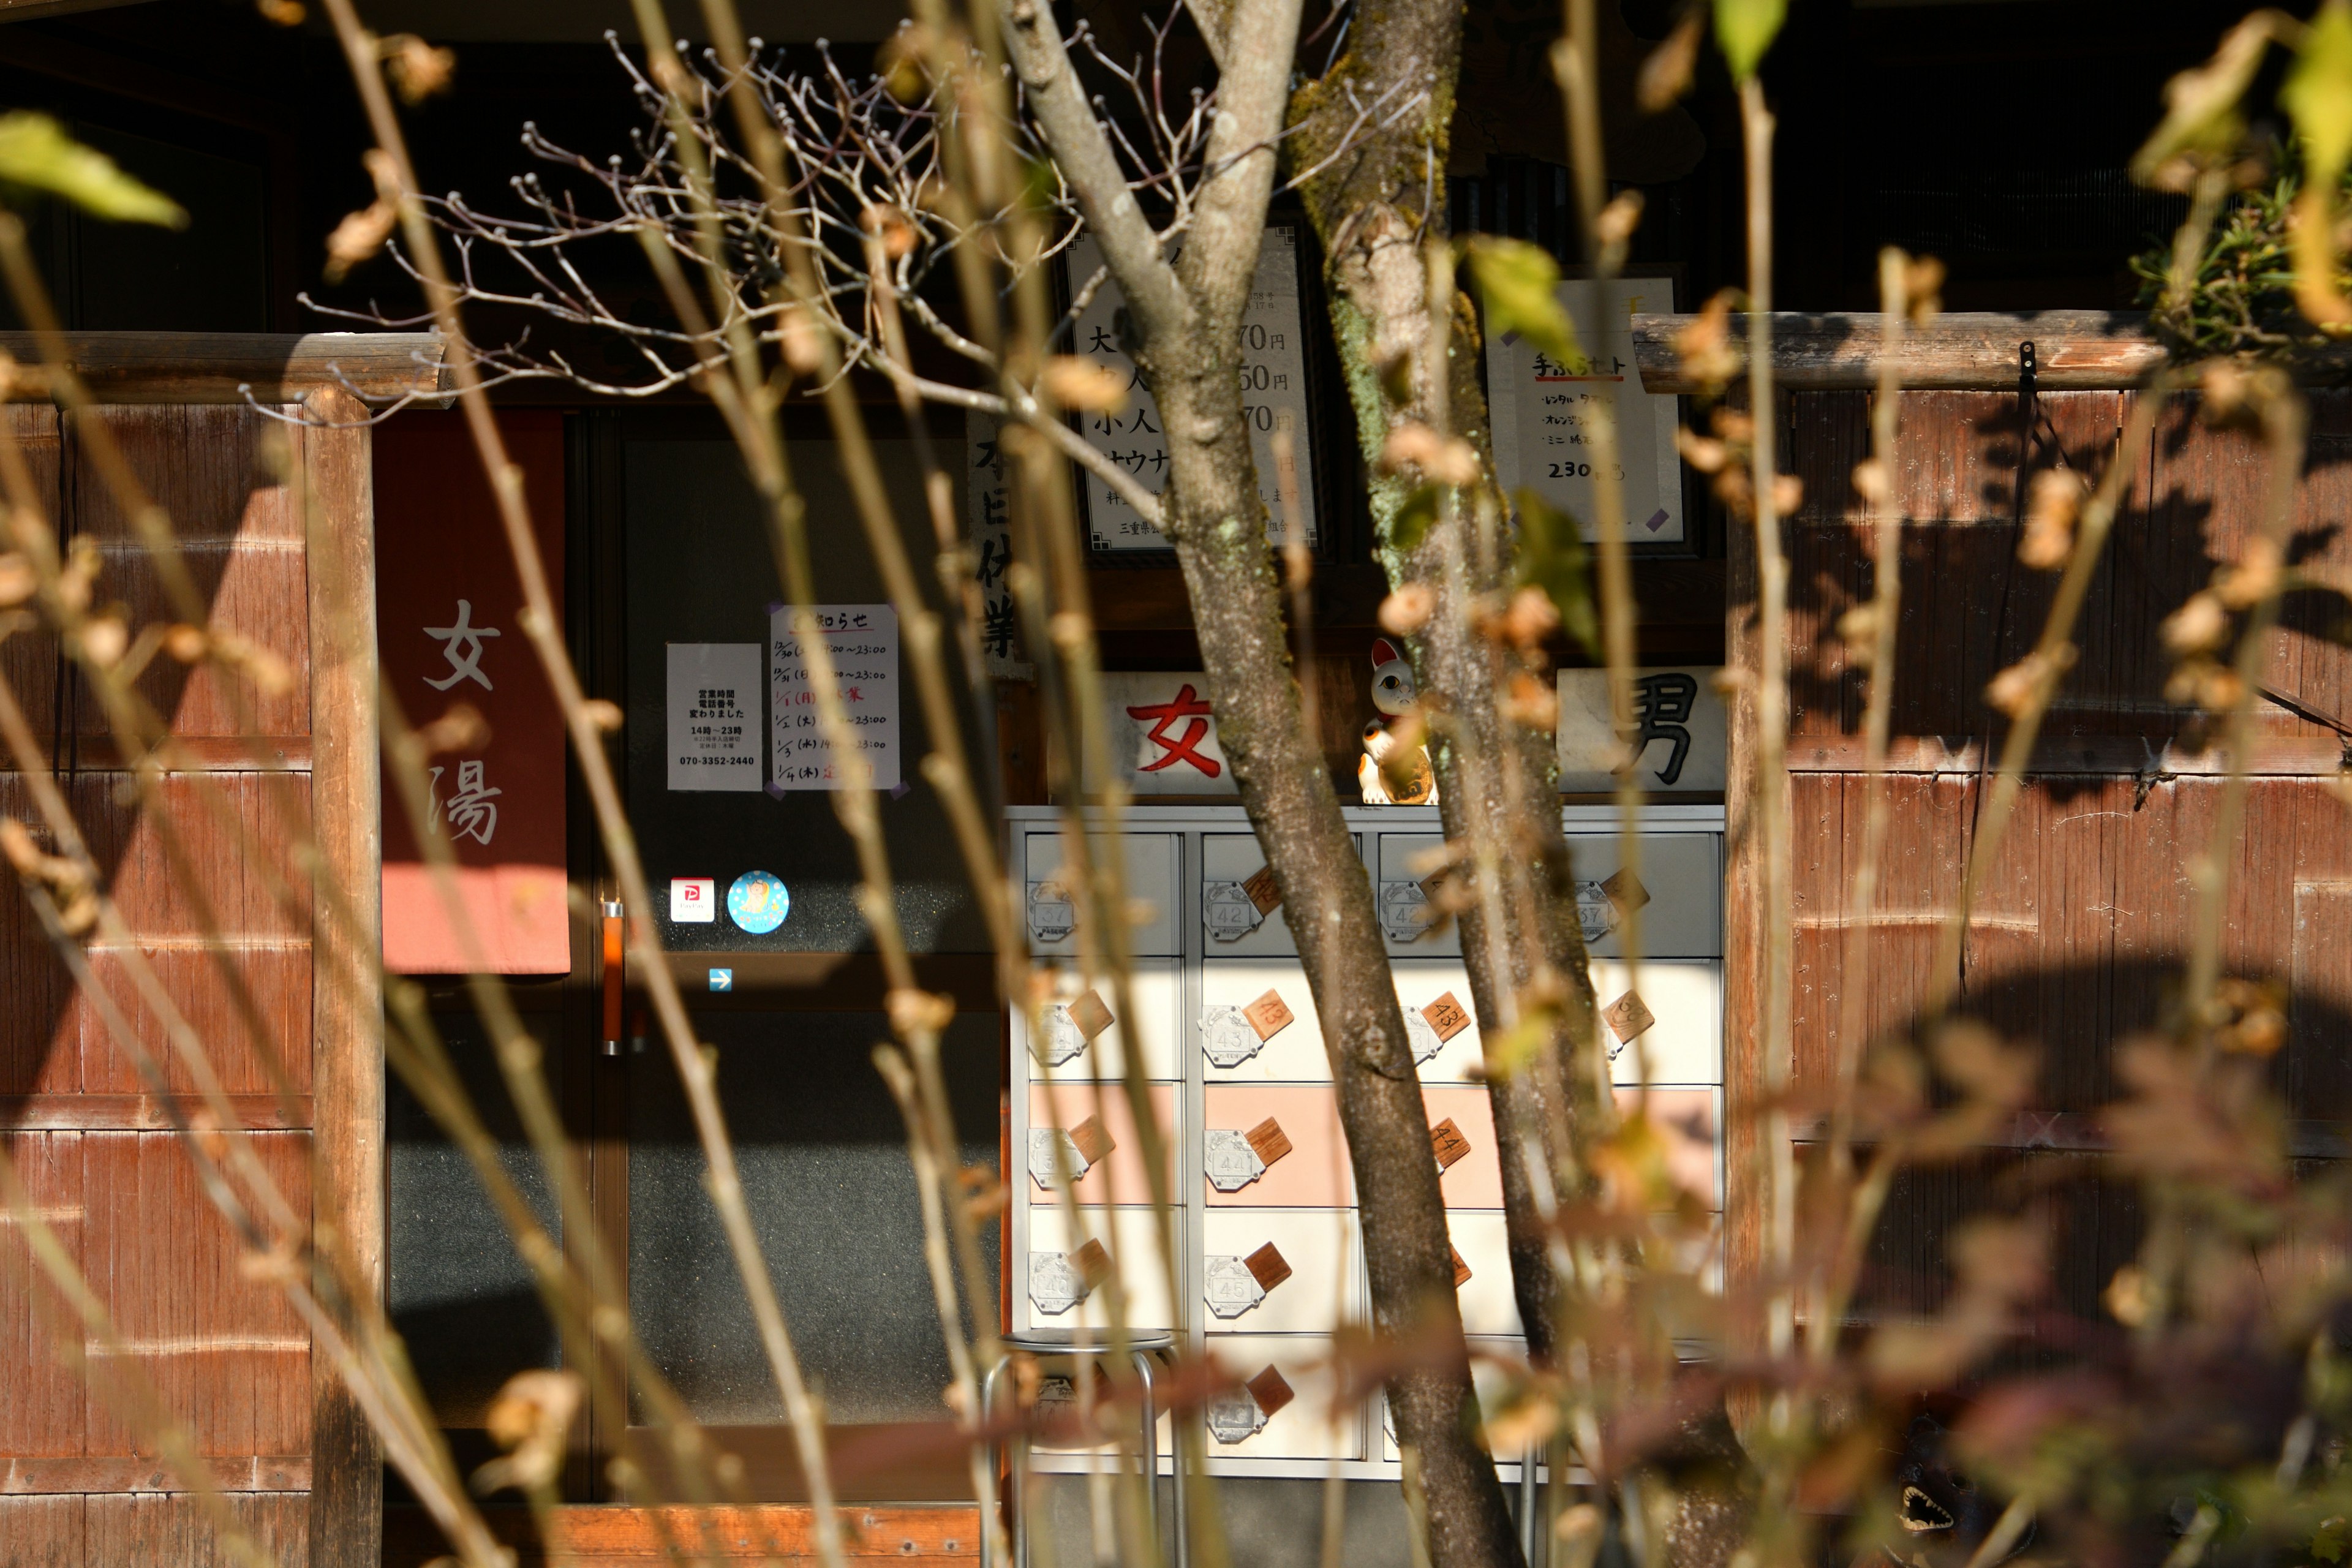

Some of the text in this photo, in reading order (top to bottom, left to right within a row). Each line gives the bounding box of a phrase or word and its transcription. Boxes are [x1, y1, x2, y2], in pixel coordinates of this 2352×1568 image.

[1095, 409, 1159, 436] 小人
[699, 690, 734, 698] 営業時間
[699, 699, 735, 708] 電話番号
[423, 599, 502, 845] 女湯
[690, 709, 744, 718] 変わりました
[1126, 684, 1221, 778] 女
[1610, 673, 1697, 786] 男
[1217, 907, 1242, 924] 42
[1435, 1005, 1458, 1027] 43
[1216, 1030, 1242, 1048] 43
[1434, 1127, 1460, 1151] 44
[1219, 1283, 1245, 1297] 45
